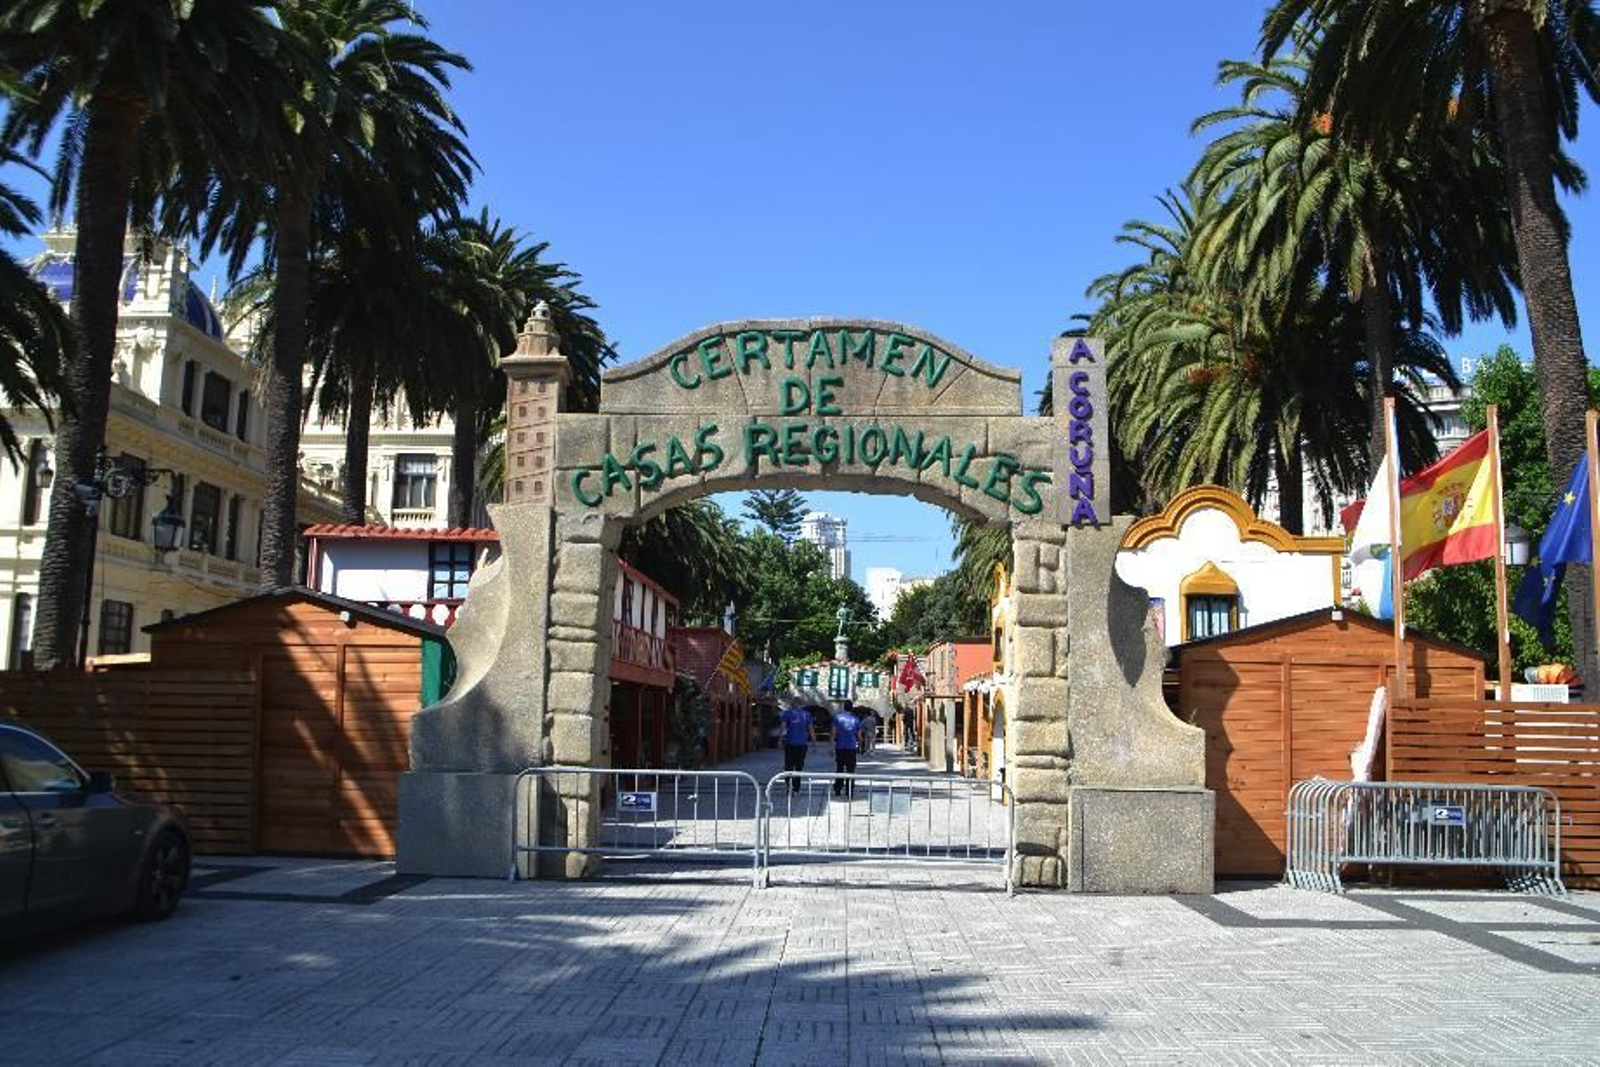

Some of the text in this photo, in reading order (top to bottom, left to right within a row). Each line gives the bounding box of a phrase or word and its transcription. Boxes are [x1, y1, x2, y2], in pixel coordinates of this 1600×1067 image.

[669, 329, 950, 389] CERTAMEN
[780, 374, 844, 416] DE
[570, 422, 1052, 515] CASAS REGIONALES
[1069, 338, 1100, 530] A CORUÑA
